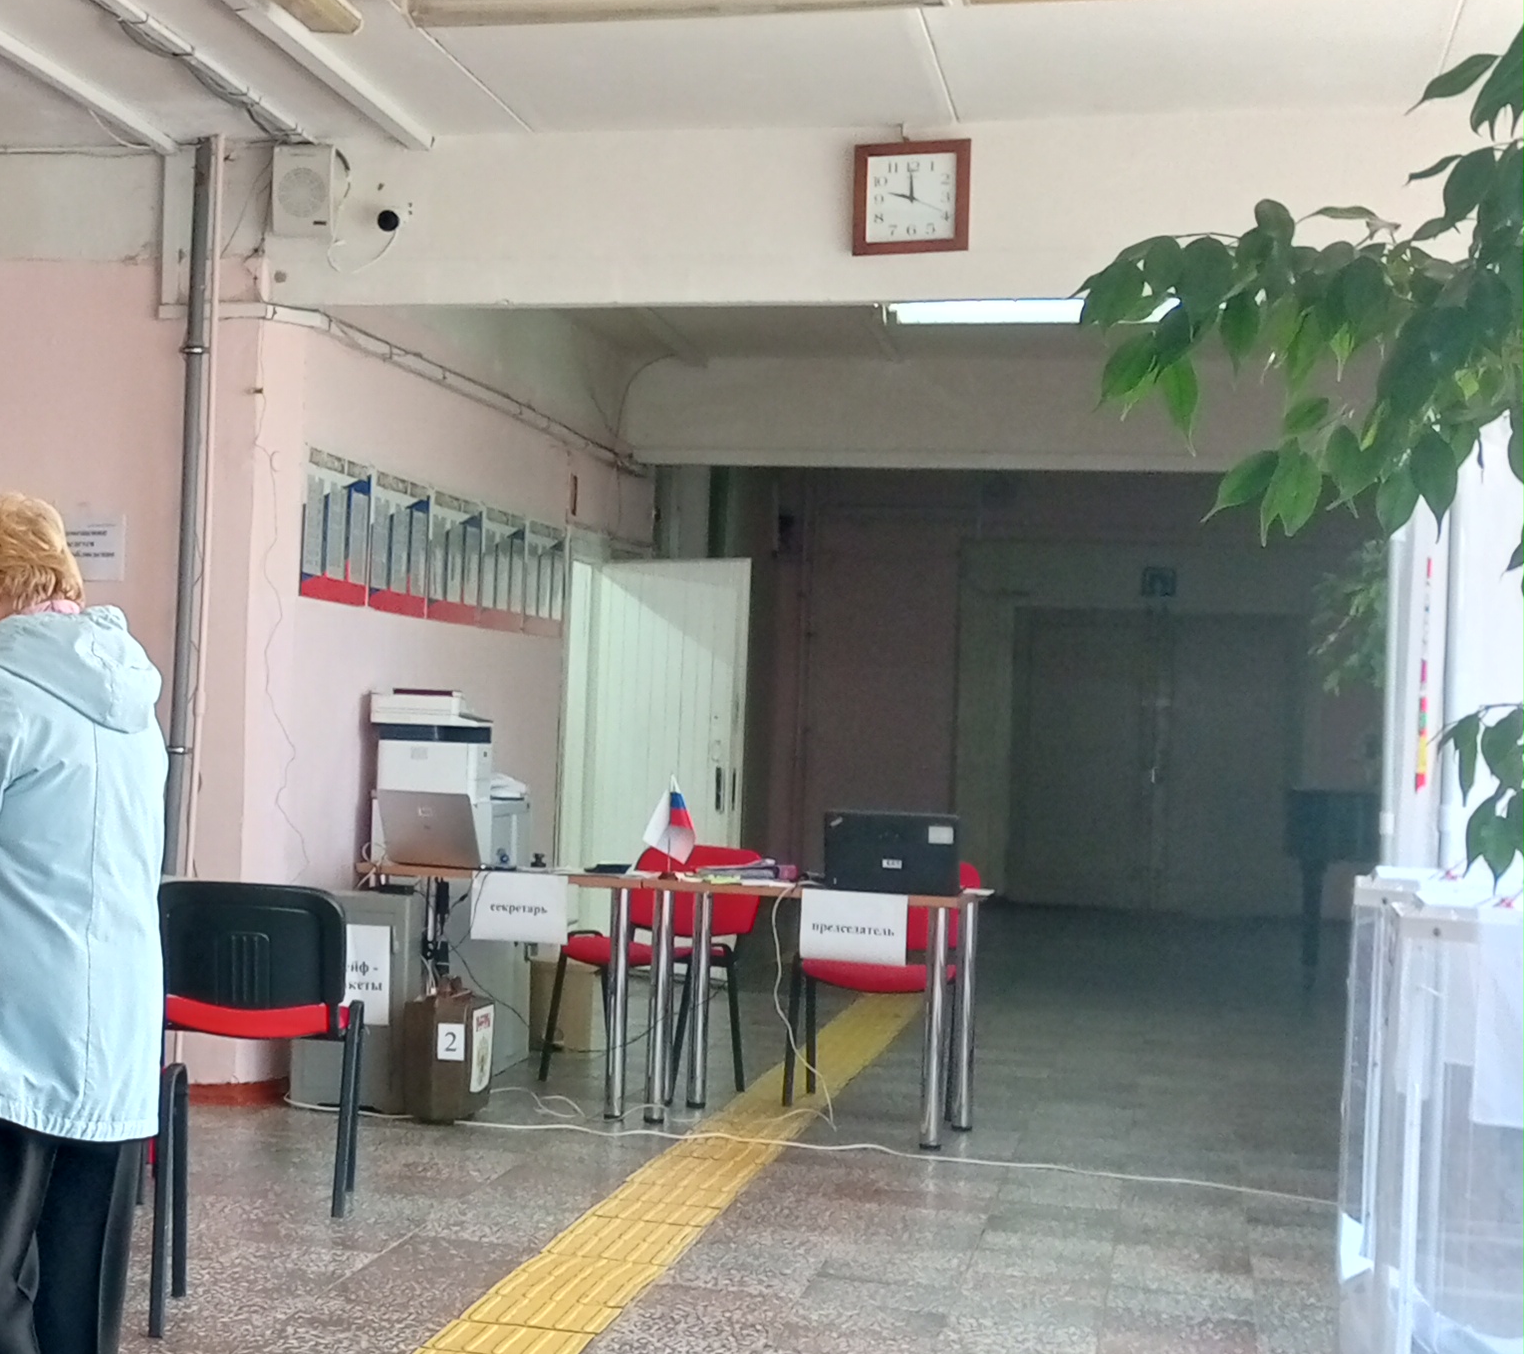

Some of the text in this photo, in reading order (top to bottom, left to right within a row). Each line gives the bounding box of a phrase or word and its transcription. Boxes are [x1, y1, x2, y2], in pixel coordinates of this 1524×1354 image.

[489, 903, 549, 916] секретарь
[811, 922, 895, 937] председатель
[347, 961, 369, 976] йф
[347, 981, 383, 991] кеты
[444, 1031, 457, 1052] 2
